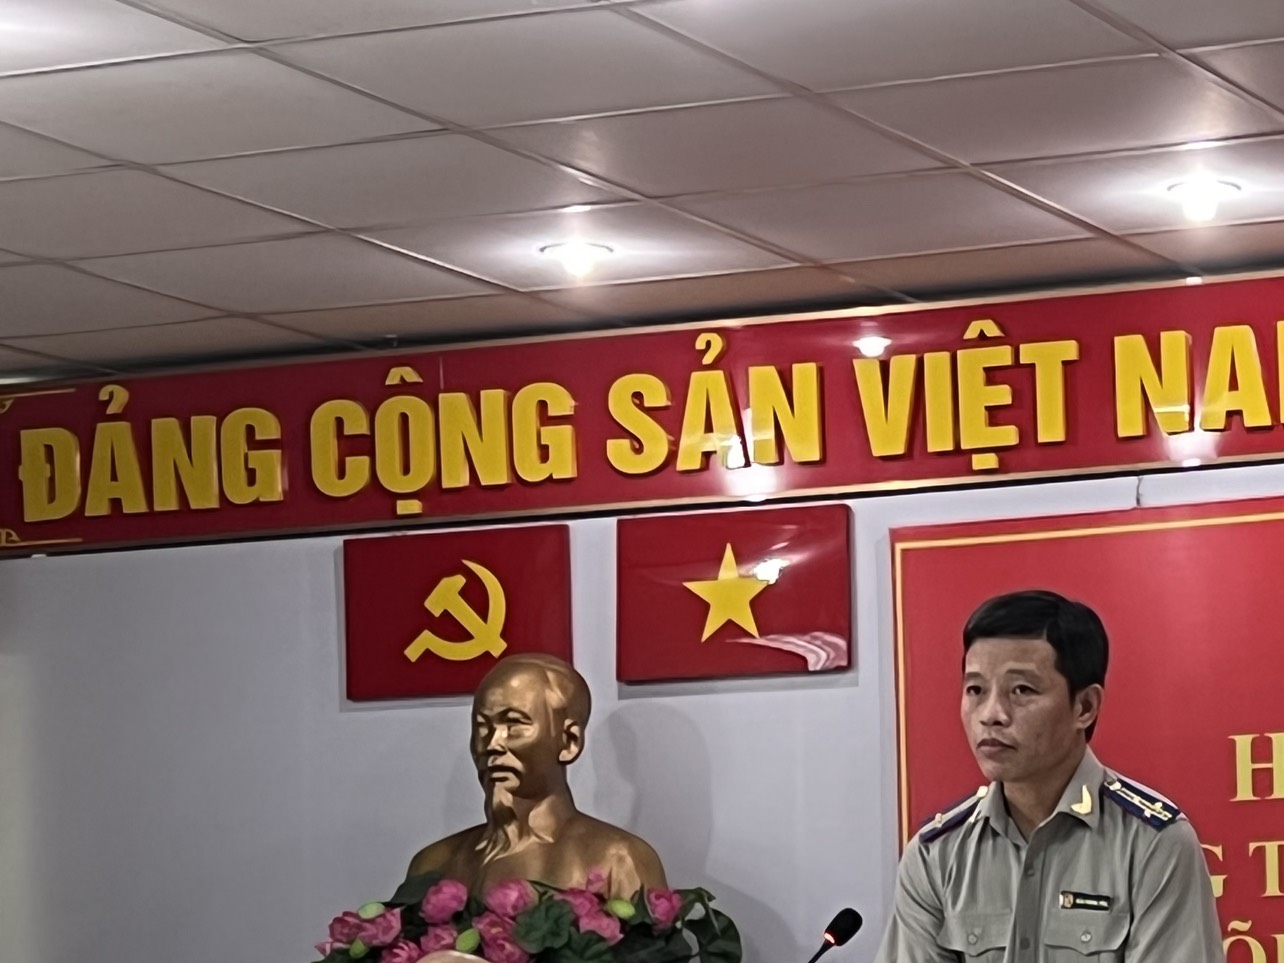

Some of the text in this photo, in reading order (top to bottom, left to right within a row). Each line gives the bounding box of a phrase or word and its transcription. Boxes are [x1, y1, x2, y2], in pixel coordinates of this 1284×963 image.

[19, 385, 286, 523] ĐẢNG
[309, 367, 578, 514] CỘNG
[606, 333, 822, 474] SẢN
[853, 320, 1079, 470] VIỆT
